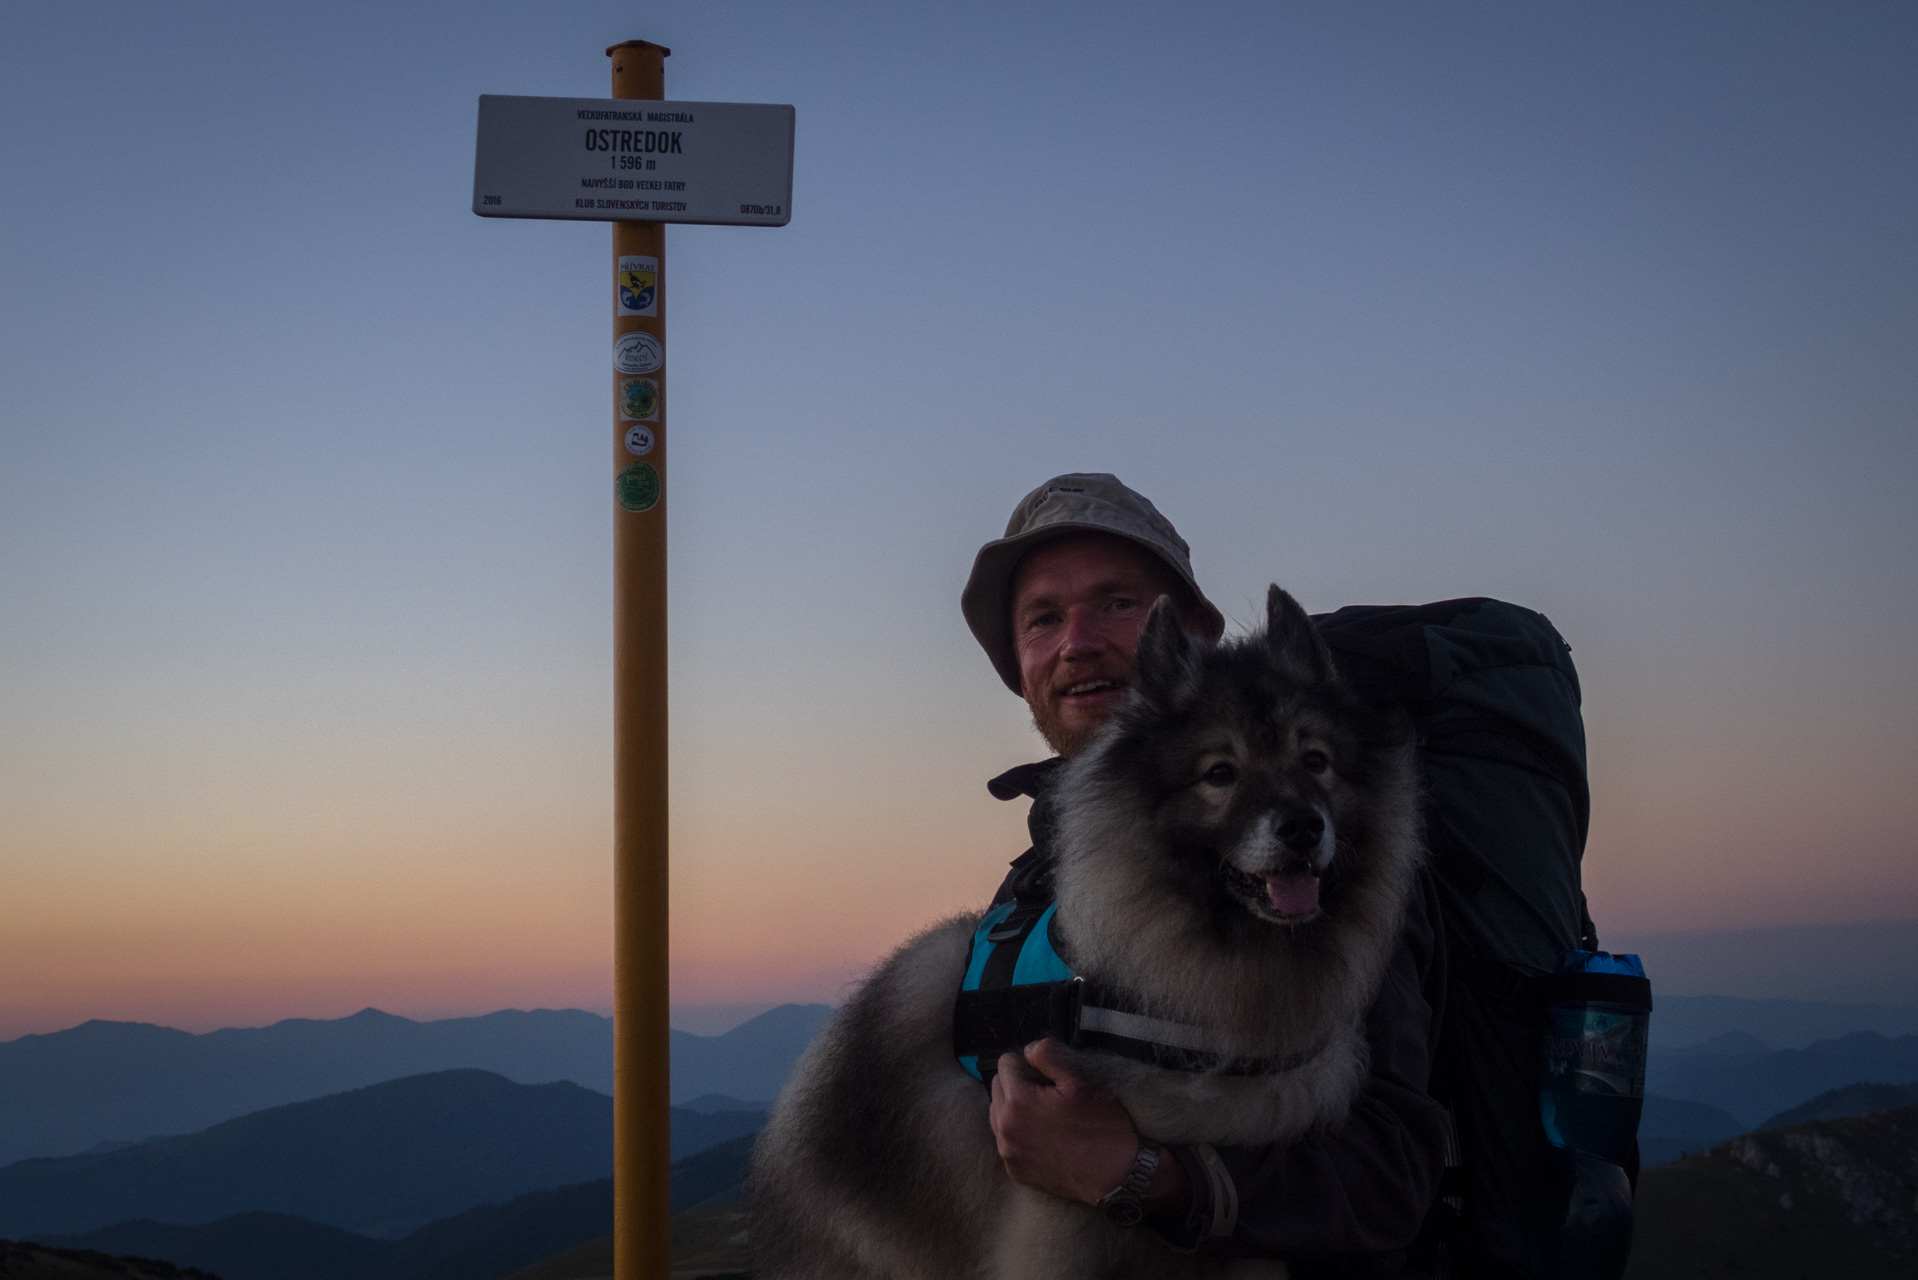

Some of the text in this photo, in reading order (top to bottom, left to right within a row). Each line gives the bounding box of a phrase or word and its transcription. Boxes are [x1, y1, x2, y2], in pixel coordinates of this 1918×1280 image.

[577, 110, 694, 123] VEĽKOFATRANSKÁ MAGISTRÁLA
[585, 128, 683, 154] OSTREDOK
[645, 159, 656, 170] m
[581, 177, 617, 189] NAJVYŠŠÍ
[618, 180, 634, 189] BOD
[664, 181, 686, 191] FATRY
[483, 195, 502, 205] 2016
[575, 198, 687, 211] KLUB SLOVENSKÝCH TURISTOV
[620, 261, 655, 272] PŘÍVRAT
